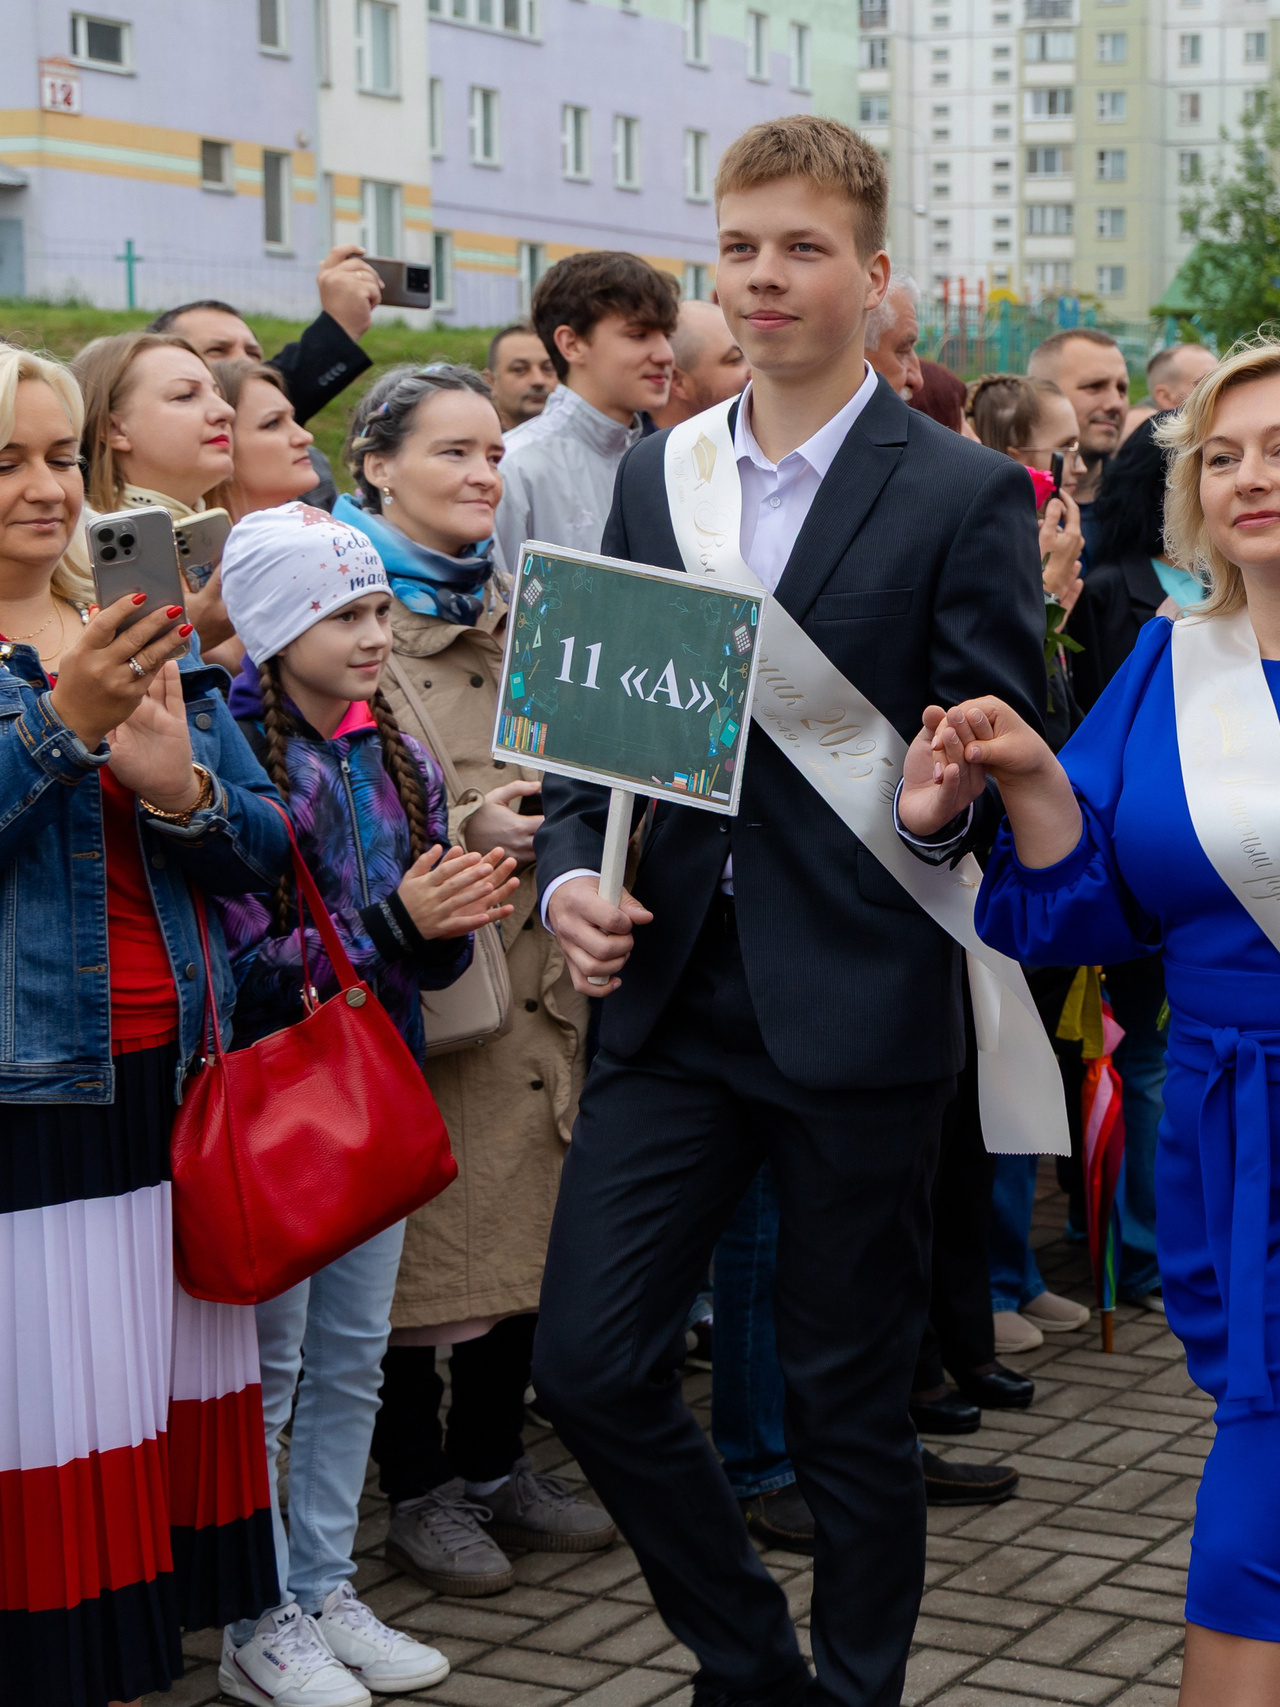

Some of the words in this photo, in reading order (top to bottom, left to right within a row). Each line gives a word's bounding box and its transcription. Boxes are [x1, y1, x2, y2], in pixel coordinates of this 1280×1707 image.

[50, 83, 73, 107] 12
[554, 636, 603, 690] 11
[619, 658, 715, 713] «А»
[799, 707, 894, 779] 2025
[262, 1650, 280, 1667] adidas
